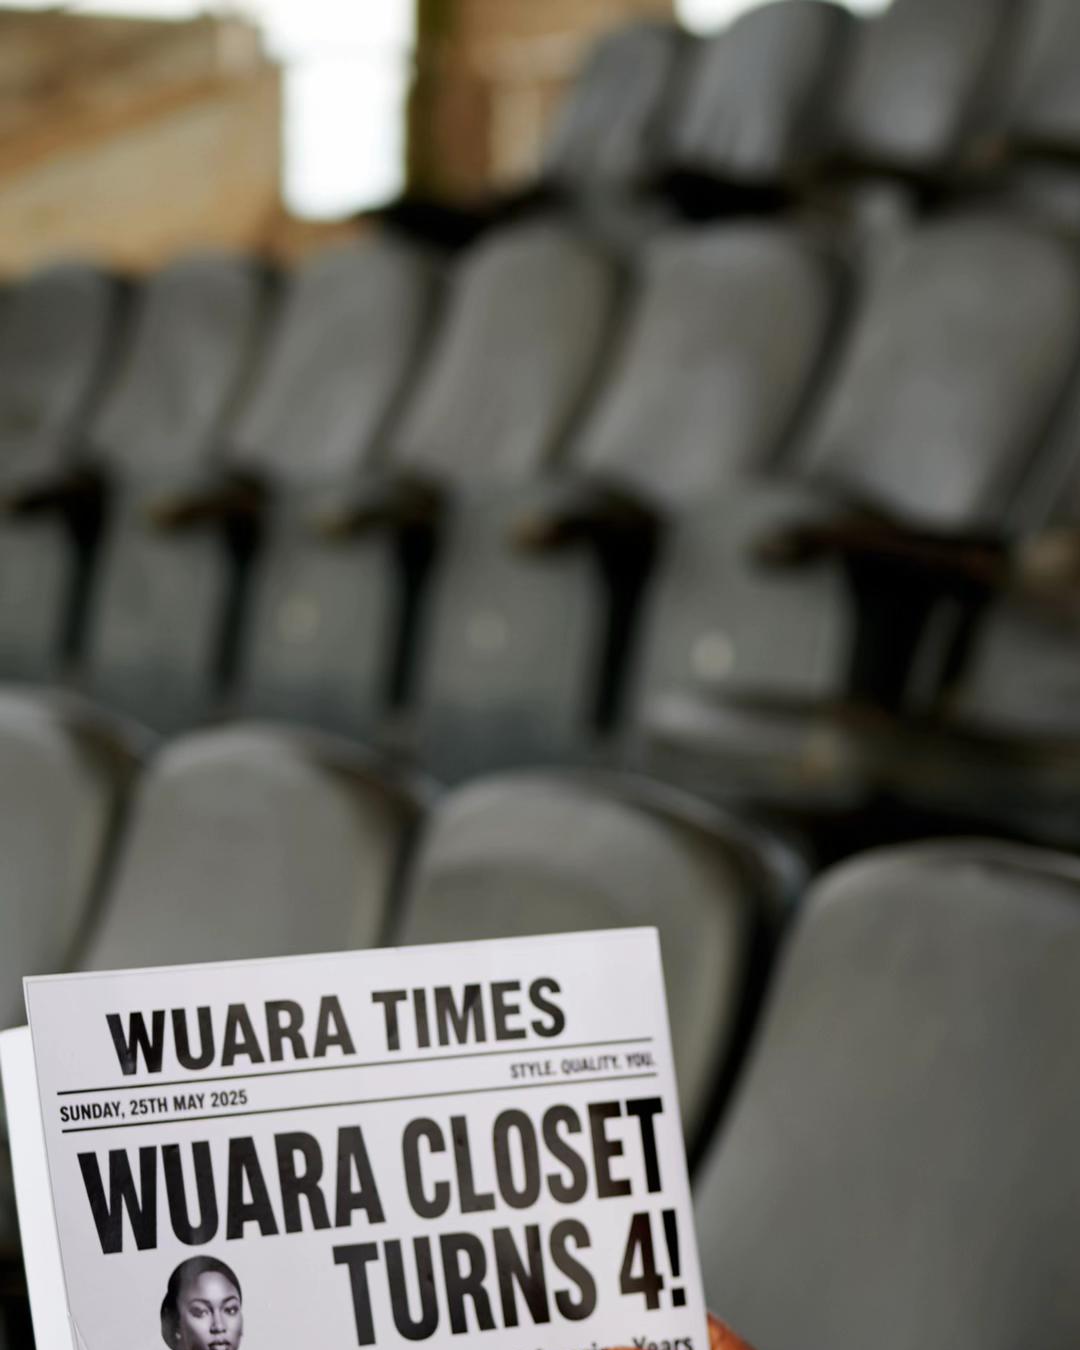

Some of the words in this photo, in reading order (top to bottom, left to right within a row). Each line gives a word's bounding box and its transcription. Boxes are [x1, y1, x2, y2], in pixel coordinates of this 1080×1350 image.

[105, 994, 357, 1076] WUARA
[371, 976, 567, 1053] TIMES
[509, 1060, 556, 1079] STYLE.
[560, 1053, 622, 1075] QUALITY.
[625, 1052, 657, 1068] YOU.
[59, 1100, 126, 1122] SUNDAY,
[129, 1096, 169, 1116] 25TH
[172, 1093, 206, 1112] MAY
[210, 1089, 248, 1108] 2025
[76, 1125, 386, 1255] WUARA
[399, 1096, 664, 1219] CLOSET
[332, 1216, 599, 1348] TURNS
[619, 1208, 687, 1311] 4!
